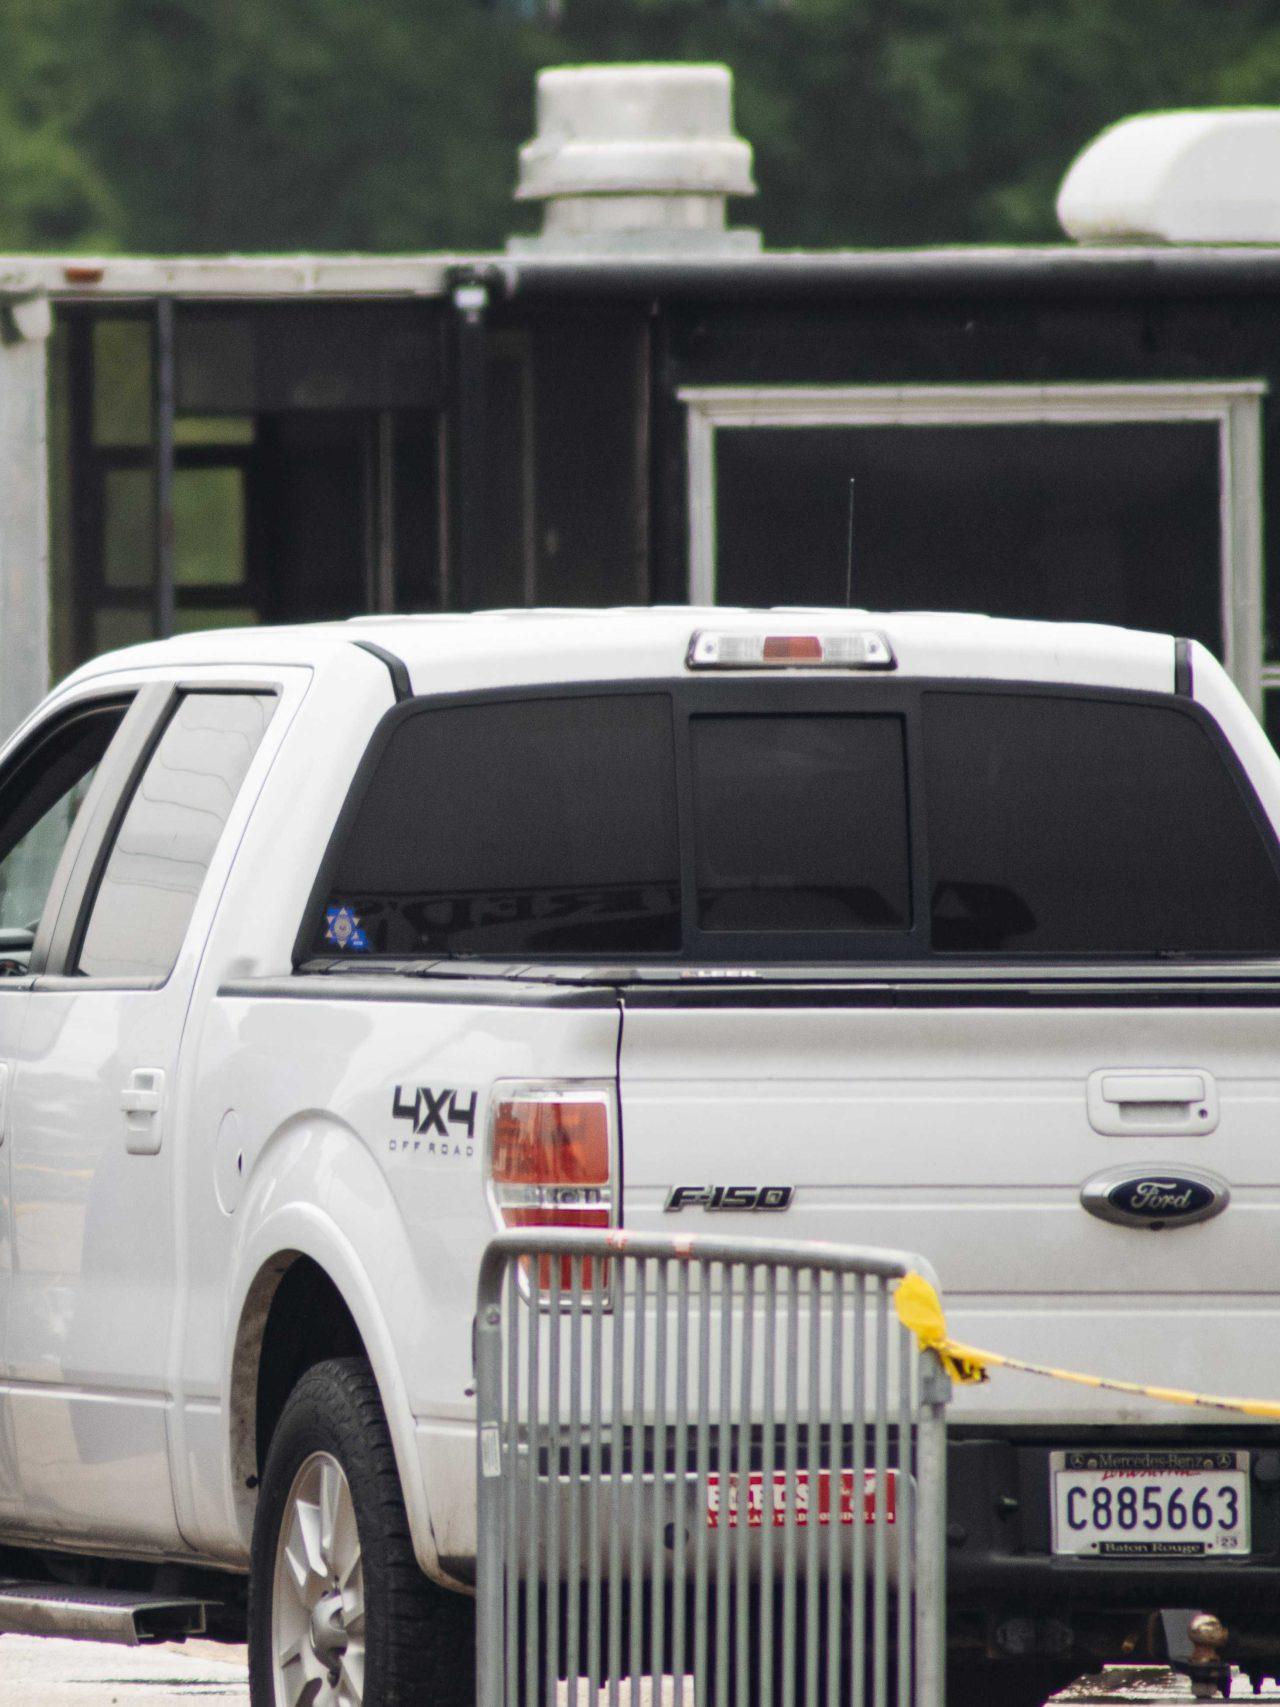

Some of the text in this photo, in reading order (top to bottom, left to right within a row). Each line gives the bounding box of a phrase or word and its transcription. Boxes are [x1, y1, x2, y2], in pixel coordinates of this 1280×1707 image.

[389, 1139, 474, 1157] OFF ROAD
[666, 1185, 795, 1212] F-150
[1130, 1181, 1193, 1209] Ford
[1098, 1452, 1202, 1468] Mercedes-Benz
[1067, 1486, 1238, 1530] C885663
[1105, 1543, 1200, 1553] Baton Rouge
